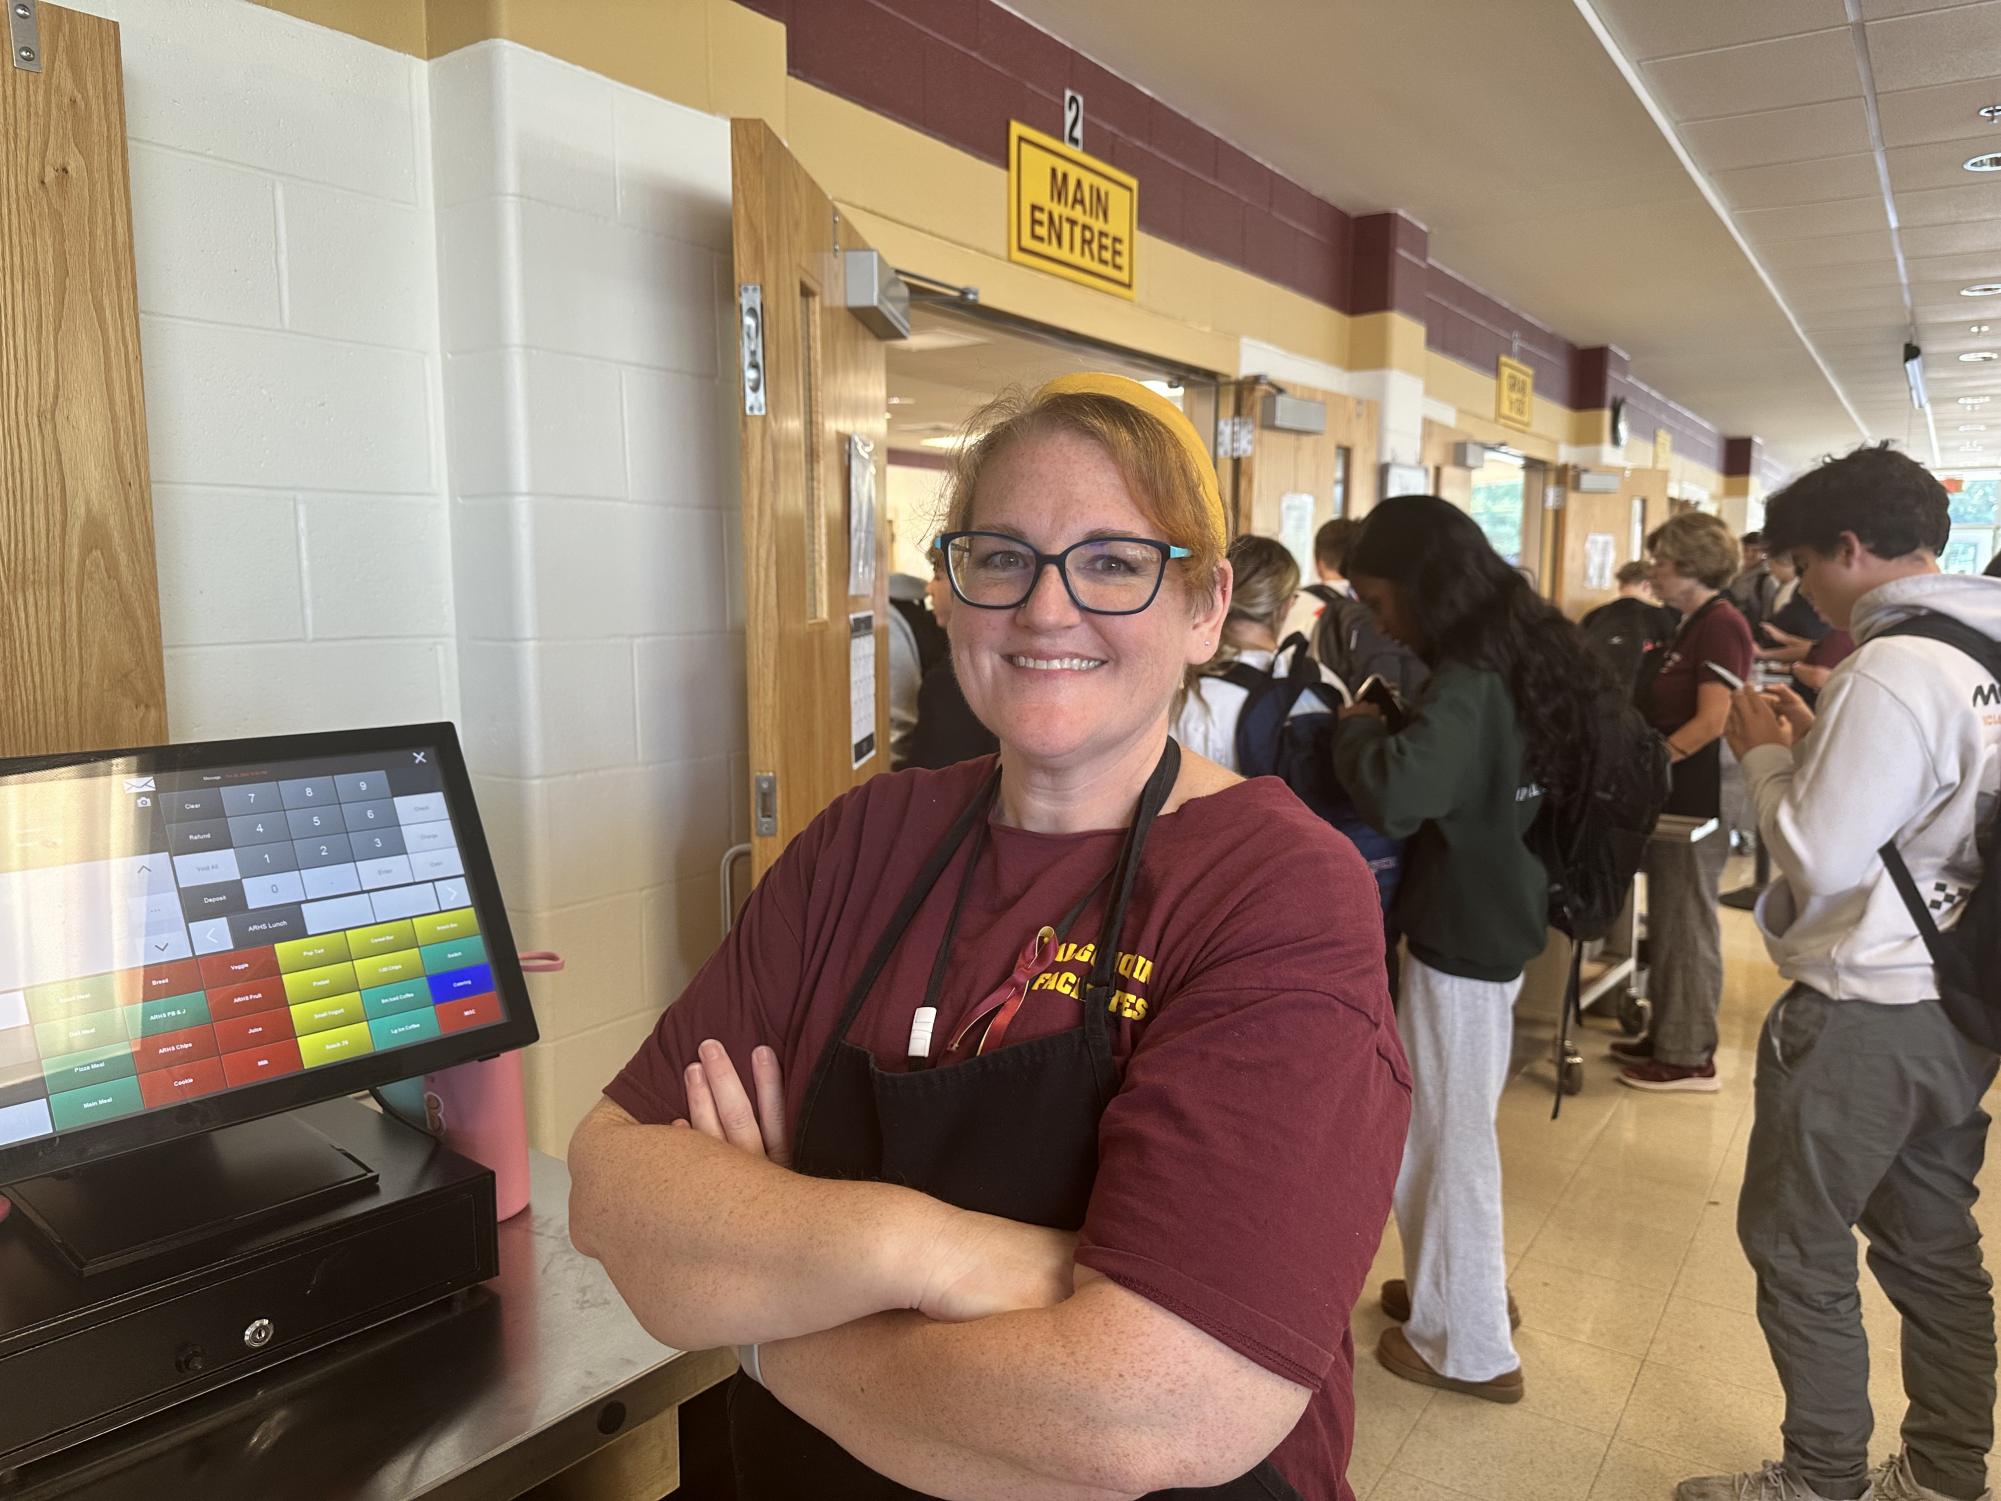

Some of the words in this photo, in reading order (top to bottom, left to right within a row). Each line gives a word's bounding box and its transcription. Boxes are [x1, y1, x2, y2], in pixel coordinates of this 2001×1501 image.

[1068, 95, 1080, 147] 2
[1049, 167, 1110, 225] MAIN
[1030, 203, 1124, 273] ENTREE
[359, 781, 367, 791] 9
[305, 787, 313, 797] 8
[248, 793, 255, 804] 7
[367, 809, 375, 819] 6
[313, 816, 321, 826] 5
[256, 823, 264, 833] 4
[188, 833, 211, 841] Refund
[374, 838, 382, 848] 3
[320, 845, 328, 856] 2
[264, 854, 271, 864] 1
[271, 884, 279, 894] 0
[203, 895, 227, 905] Deposit
[248, 923, 267, 932] ARHS
[268, 920, 288, 929] Lunch
[230, 963, 249, 971] Veggie
[152, 978, 169, 986] Bread
[248, 1026, 263, 1034] Juice
[176, 1042, 193, 1050] Chips
[74, 1064, 90, 1073] Pizza
[91, 1061, 105, 1069] Meal
[173, 1077, 194, 1087] Cookie
[83, 1101, 98, 1109] Main
